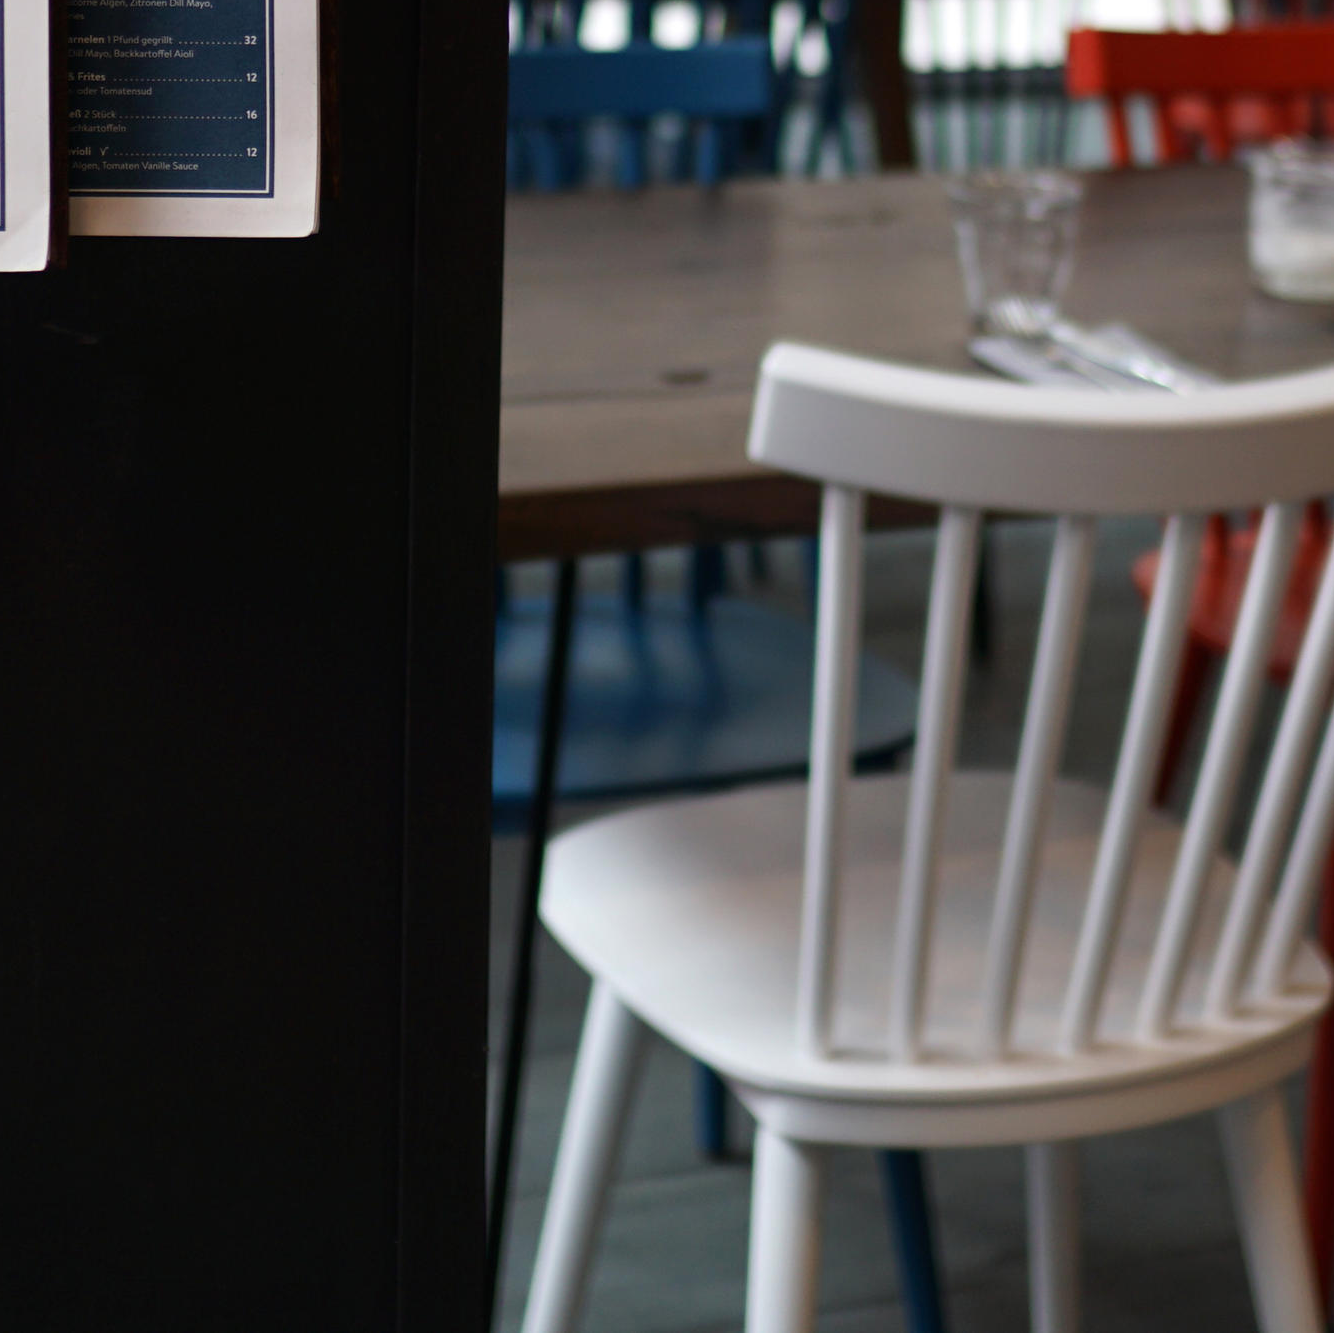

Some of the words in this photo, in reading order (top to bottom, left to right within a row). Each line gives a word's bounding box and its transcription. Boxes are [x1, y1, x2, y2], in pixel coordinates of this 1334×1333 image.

[113, 35, 139, 45] Pfund
[142, 35, 173, 46] gegrillt
[244, 35, 257, 45] 32
[77, 72, 106, 82] Frites
[246, 73, 257, 82] 12
[92, 110, 116, 119] Stück
[246, 110, 257, 120] 16
[246, 148, 257, 157] 12
